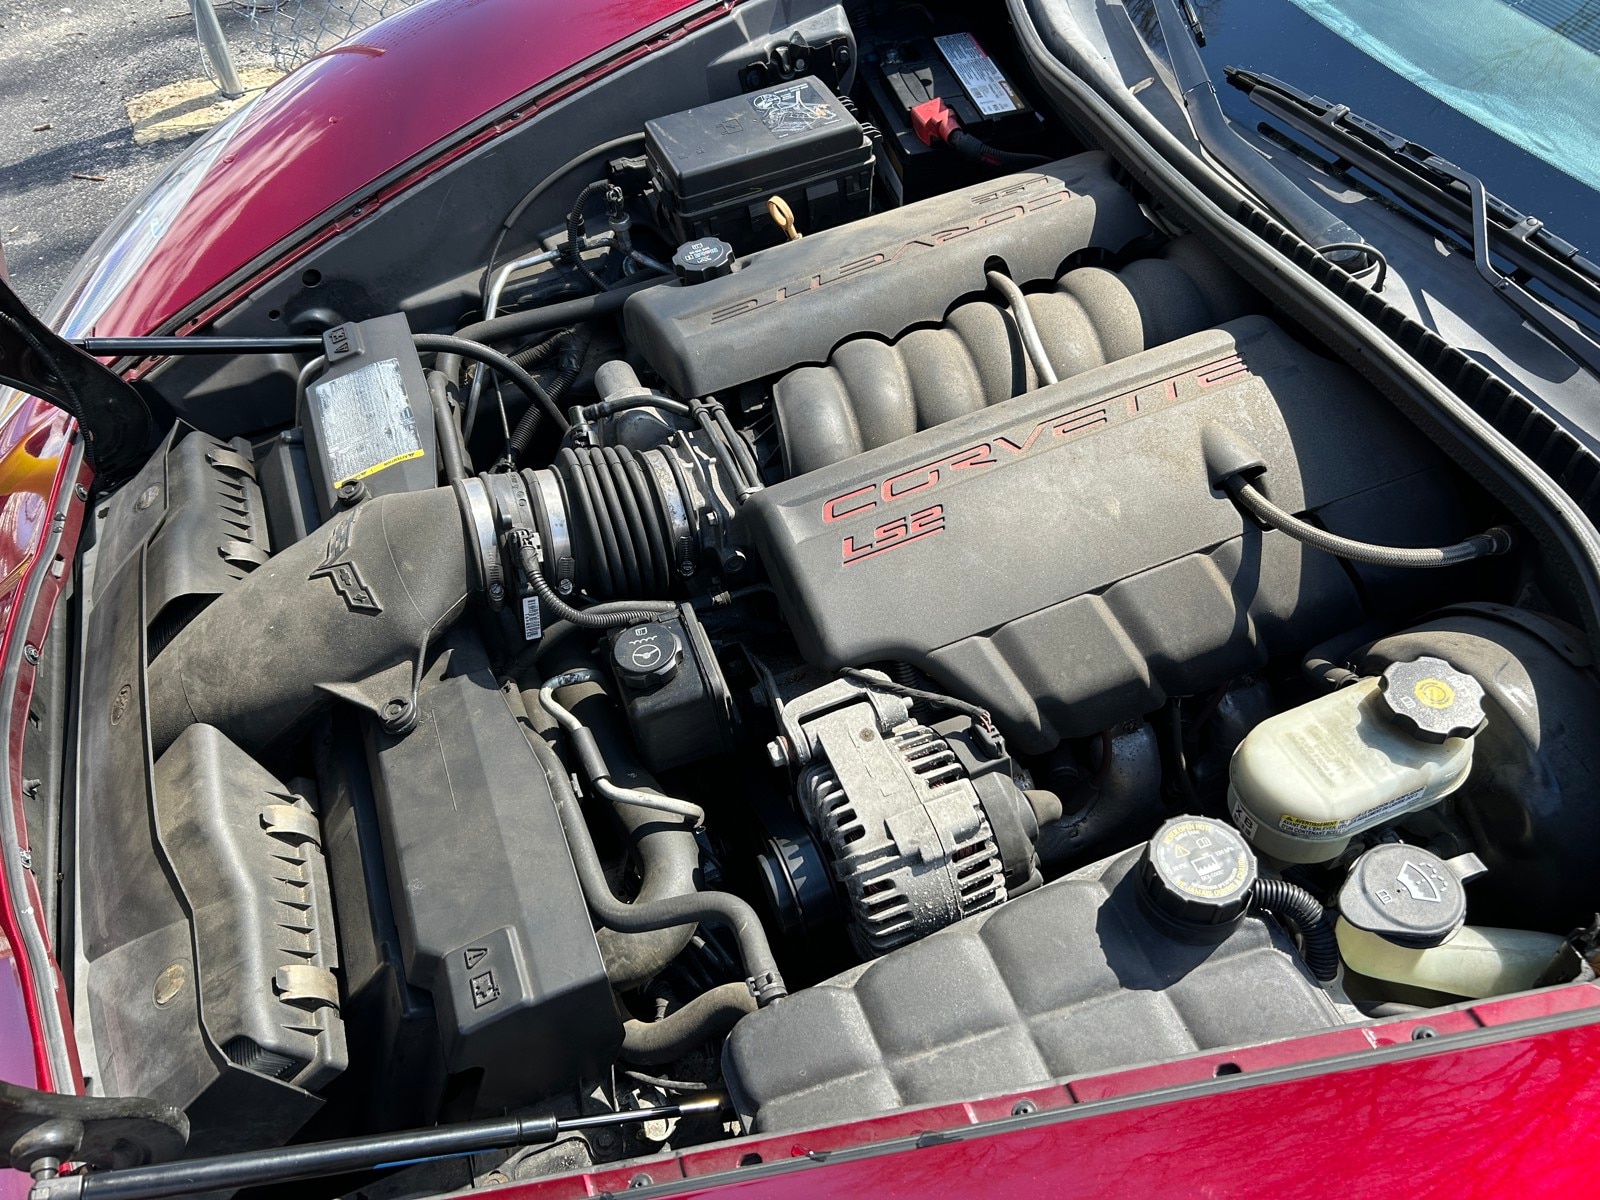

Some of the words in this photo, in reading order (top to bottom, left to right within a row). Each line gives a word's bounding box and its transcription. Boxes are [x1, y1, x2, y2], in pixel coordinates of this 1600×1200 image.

[711, 190, 1072, 325] CORVETTE
[822, 351, 1250, 524] CORVETTE
[842, 504, 945, 561] LS2
